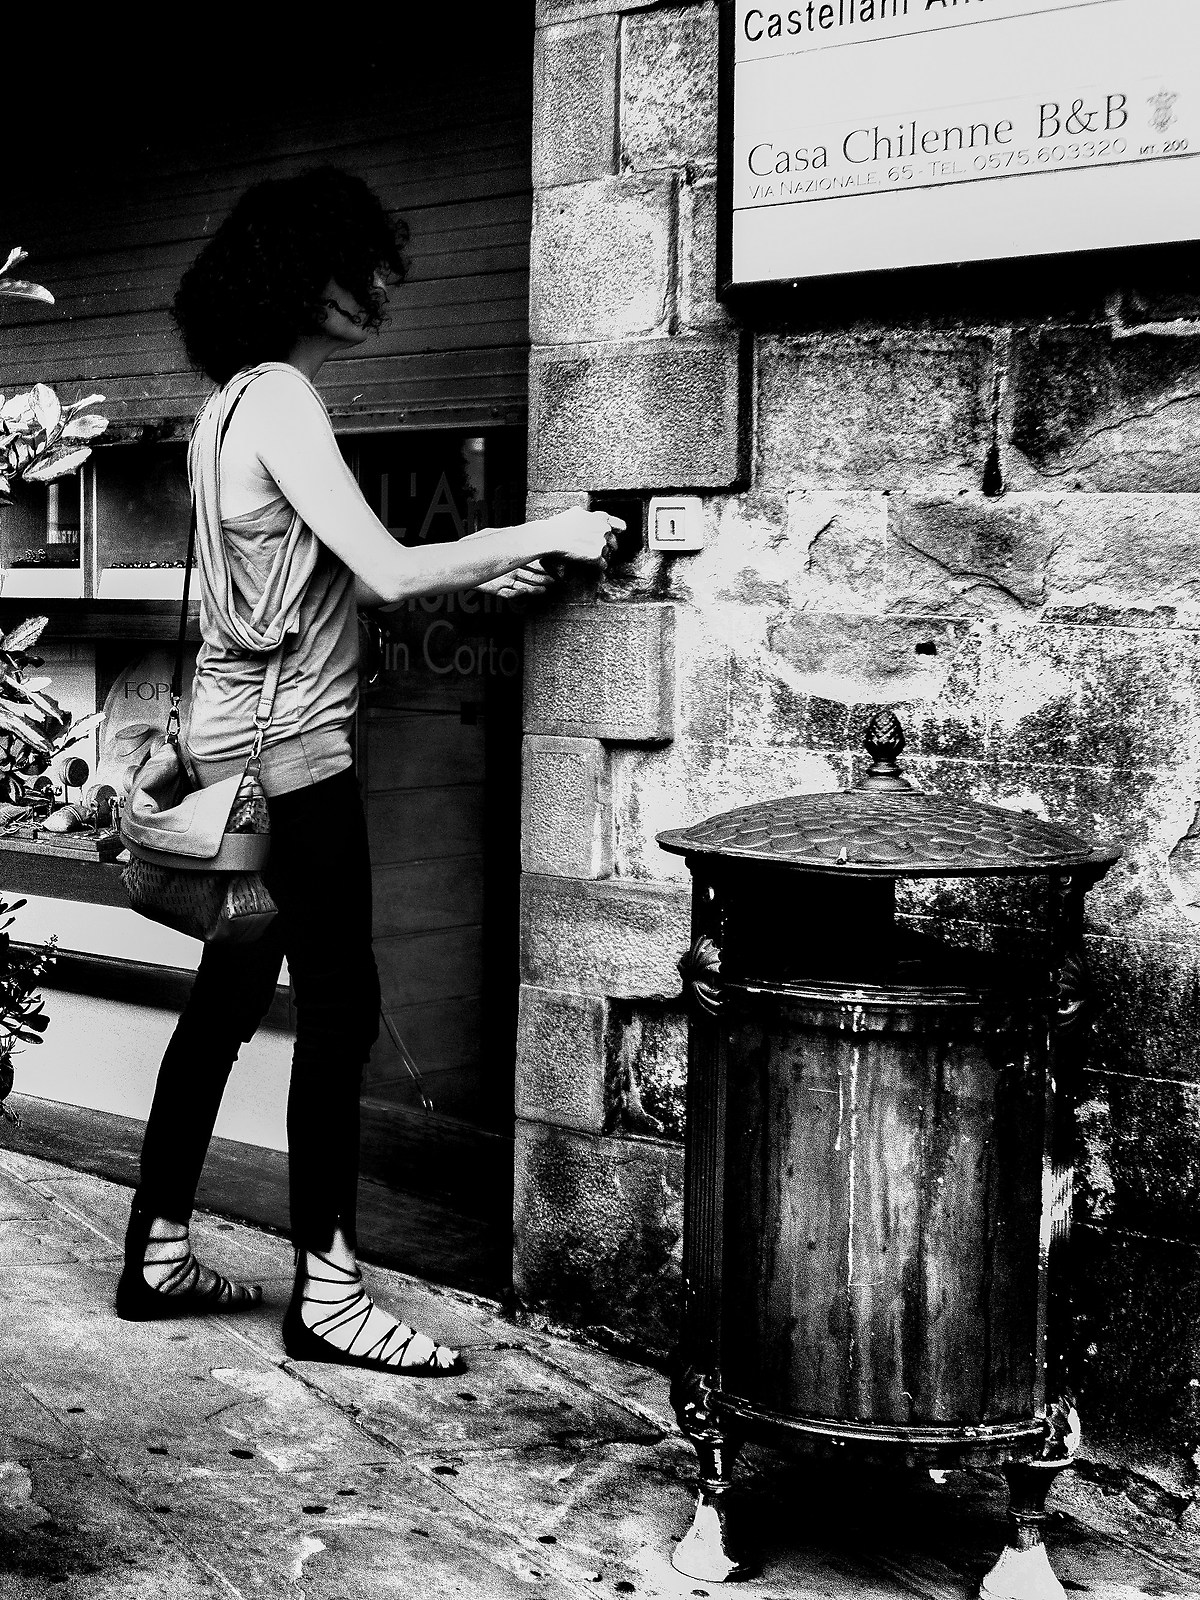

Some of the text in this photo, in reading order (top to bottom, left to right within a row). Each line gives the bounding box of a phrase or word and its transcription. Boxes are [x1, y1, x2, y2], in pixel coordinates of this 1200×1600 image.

[747, 93, 1129, 177] Casa Chilenne B&B
[749, 184, 775, 199] VIA
[887, 164, 914, 182] 65
[1162, 138, 1190, 153] 200
[385, 630, 410, 671] in
[124, 681, 173, 700] FOP
